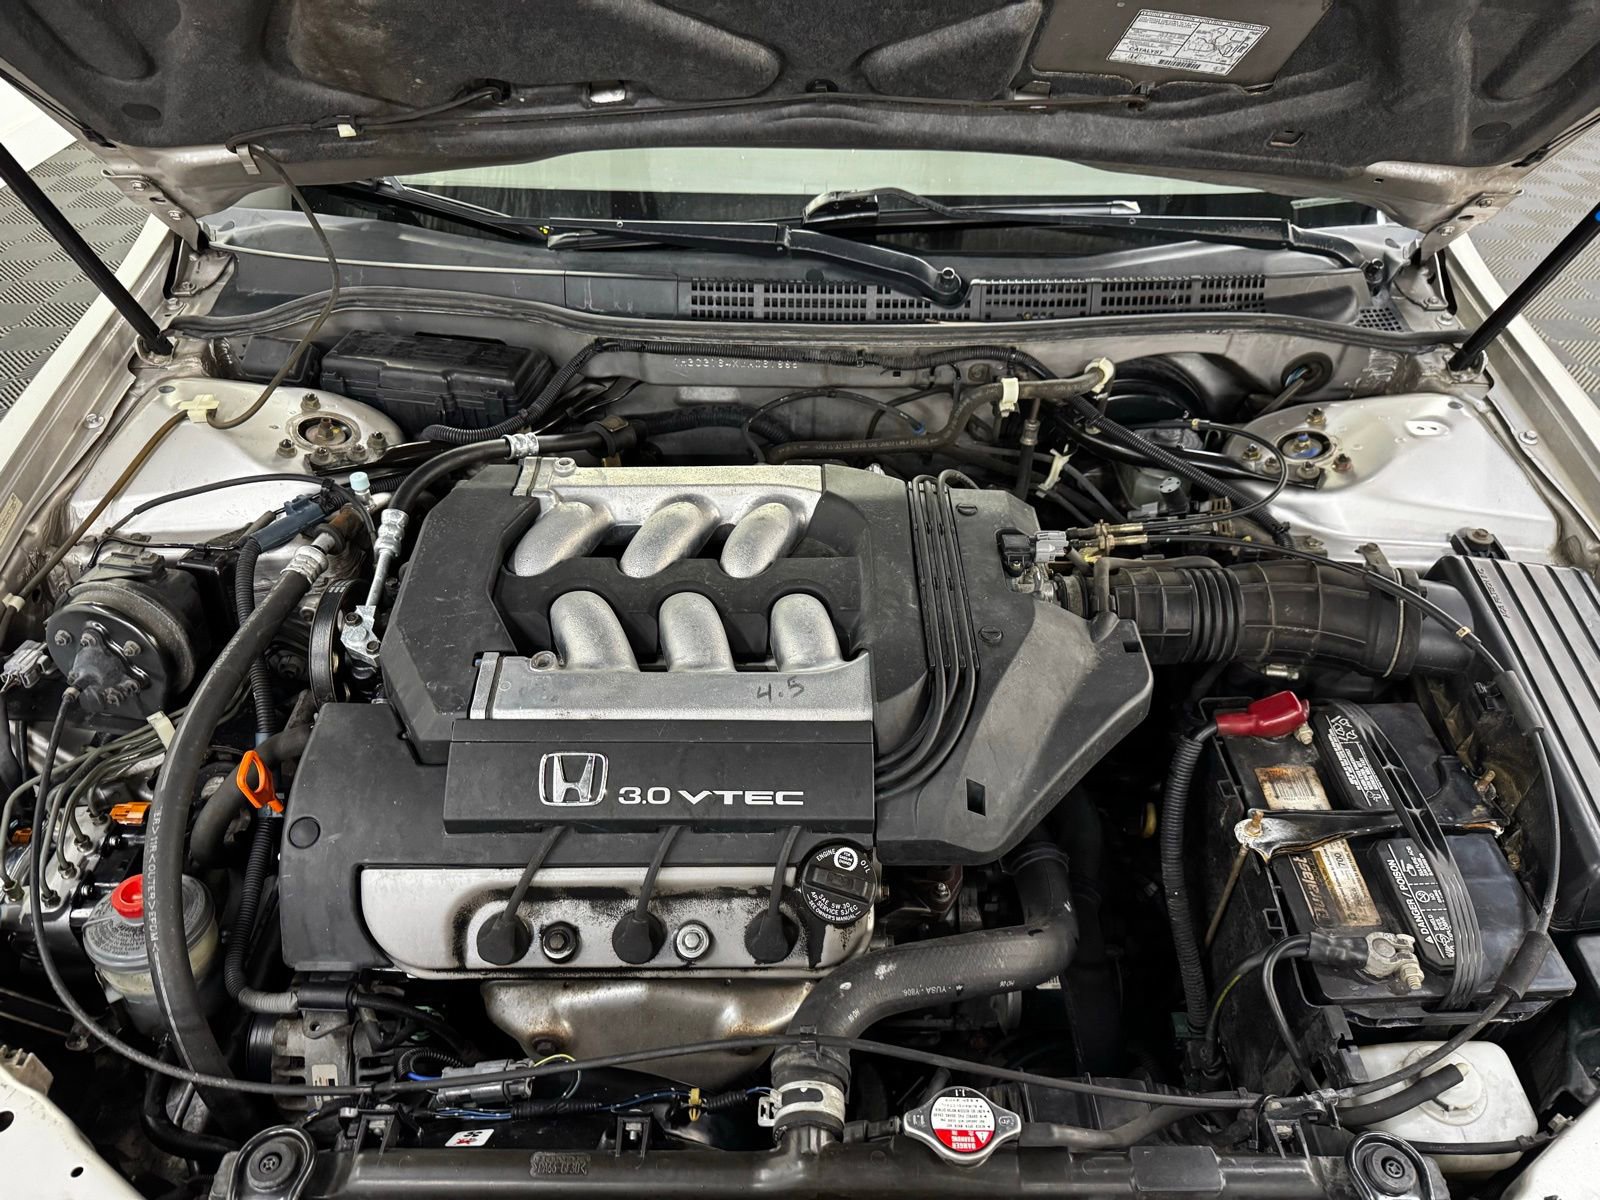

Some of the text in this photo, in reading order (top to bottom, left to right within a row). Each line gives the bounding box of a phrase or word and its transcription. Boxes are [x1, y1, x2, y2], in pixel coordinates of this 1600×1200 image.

[756, 676, 805, 701] 4.5
[618, 787, 804, 805] 3.0 VTEC
[816, 848, 871, 874] ENGINE OIL
[1333, 852, 1345, 865] 700
[1386, 859, 1408, 890] POISON
[818, 894, 829, 905] SAE
[817, 902, 839, 915] SERVICE
[1406, 899, 1429, 934] DANGER
[926, 986, 947, 994] YUSA
[955, 1089, 965, 1097] 1.1
